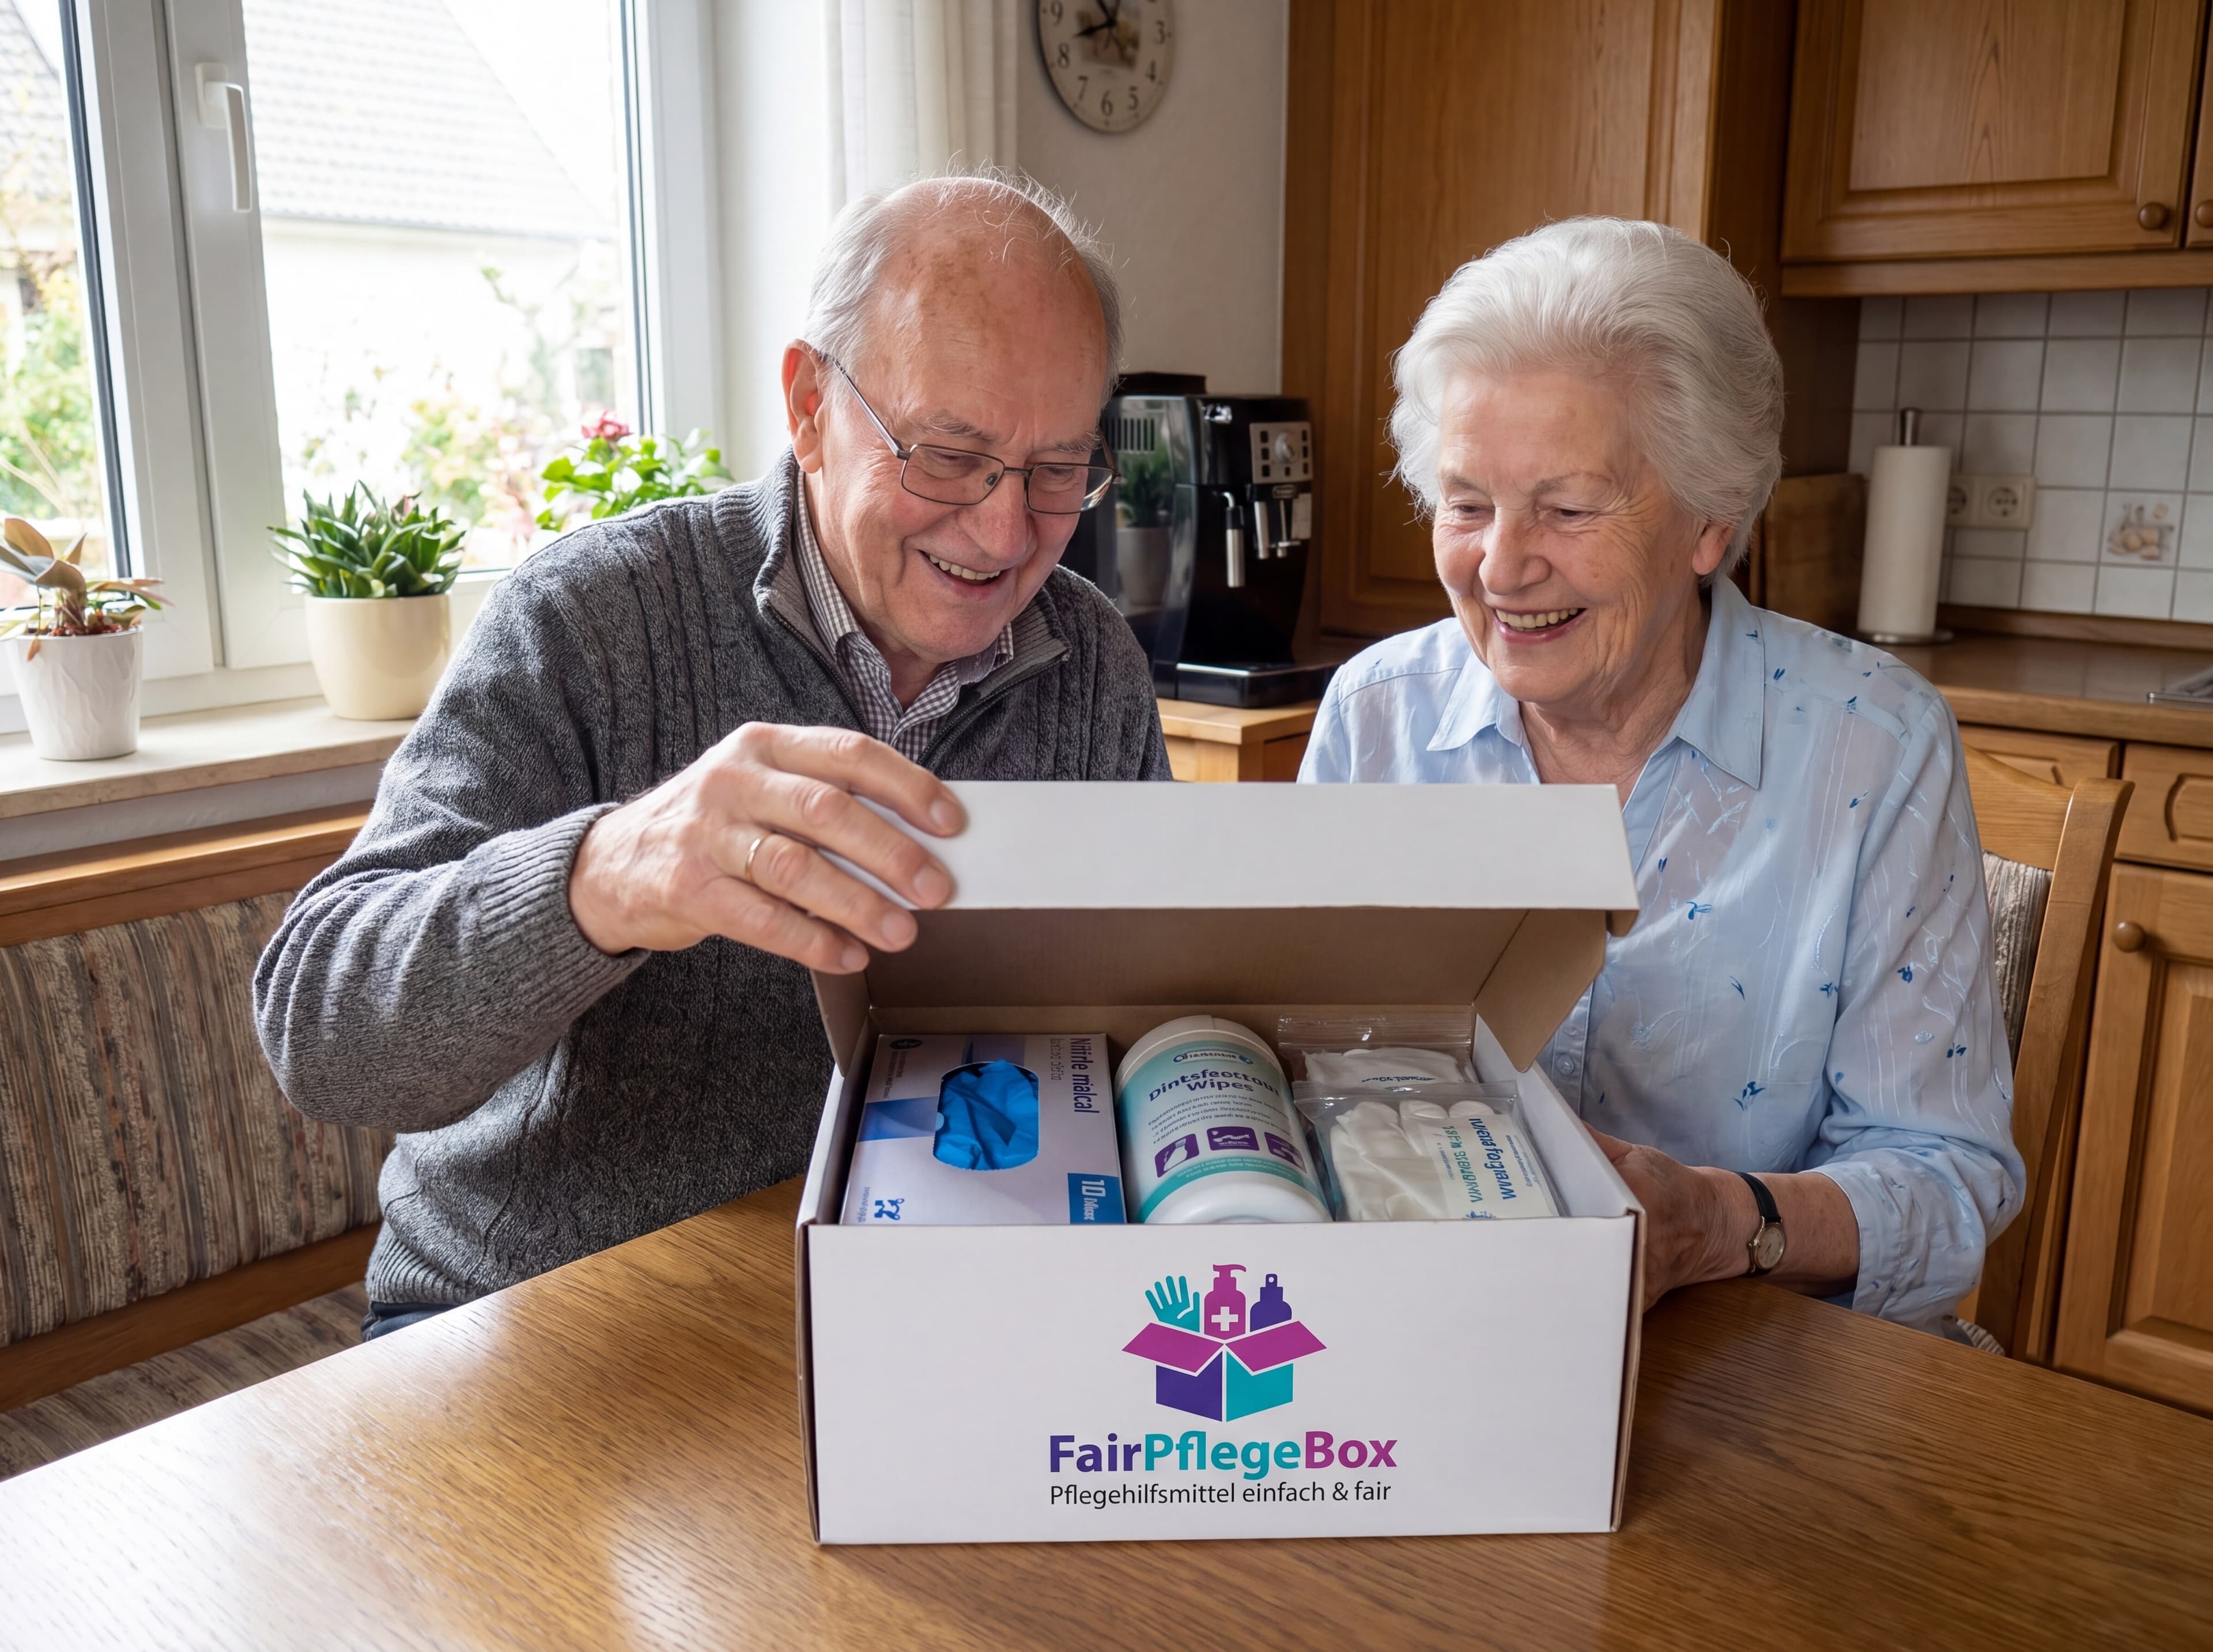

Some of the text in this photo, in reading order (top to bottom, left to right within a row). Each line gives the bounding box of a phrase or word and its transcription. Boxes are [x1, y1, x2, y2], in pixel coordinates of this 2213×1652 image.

[1050, 1, 1063, 26] 9
[1155, 20, 1166, 44] 3
[1058, 43, 1070, 68] 8
[1146, 60, 1156, 82] 4
[1078, 75, 1089, 101] 7
[1128, 86, 1139, 111] 5
[1101, 89, 1113, 116] 6
[1187, 1079, 1255, 1092] Wipes
[1049, 1430, 1398, 1481] FairPflegeBox
[1050, 1480, 1391, 1510] Pflegehilfsmittel einfach & fair
